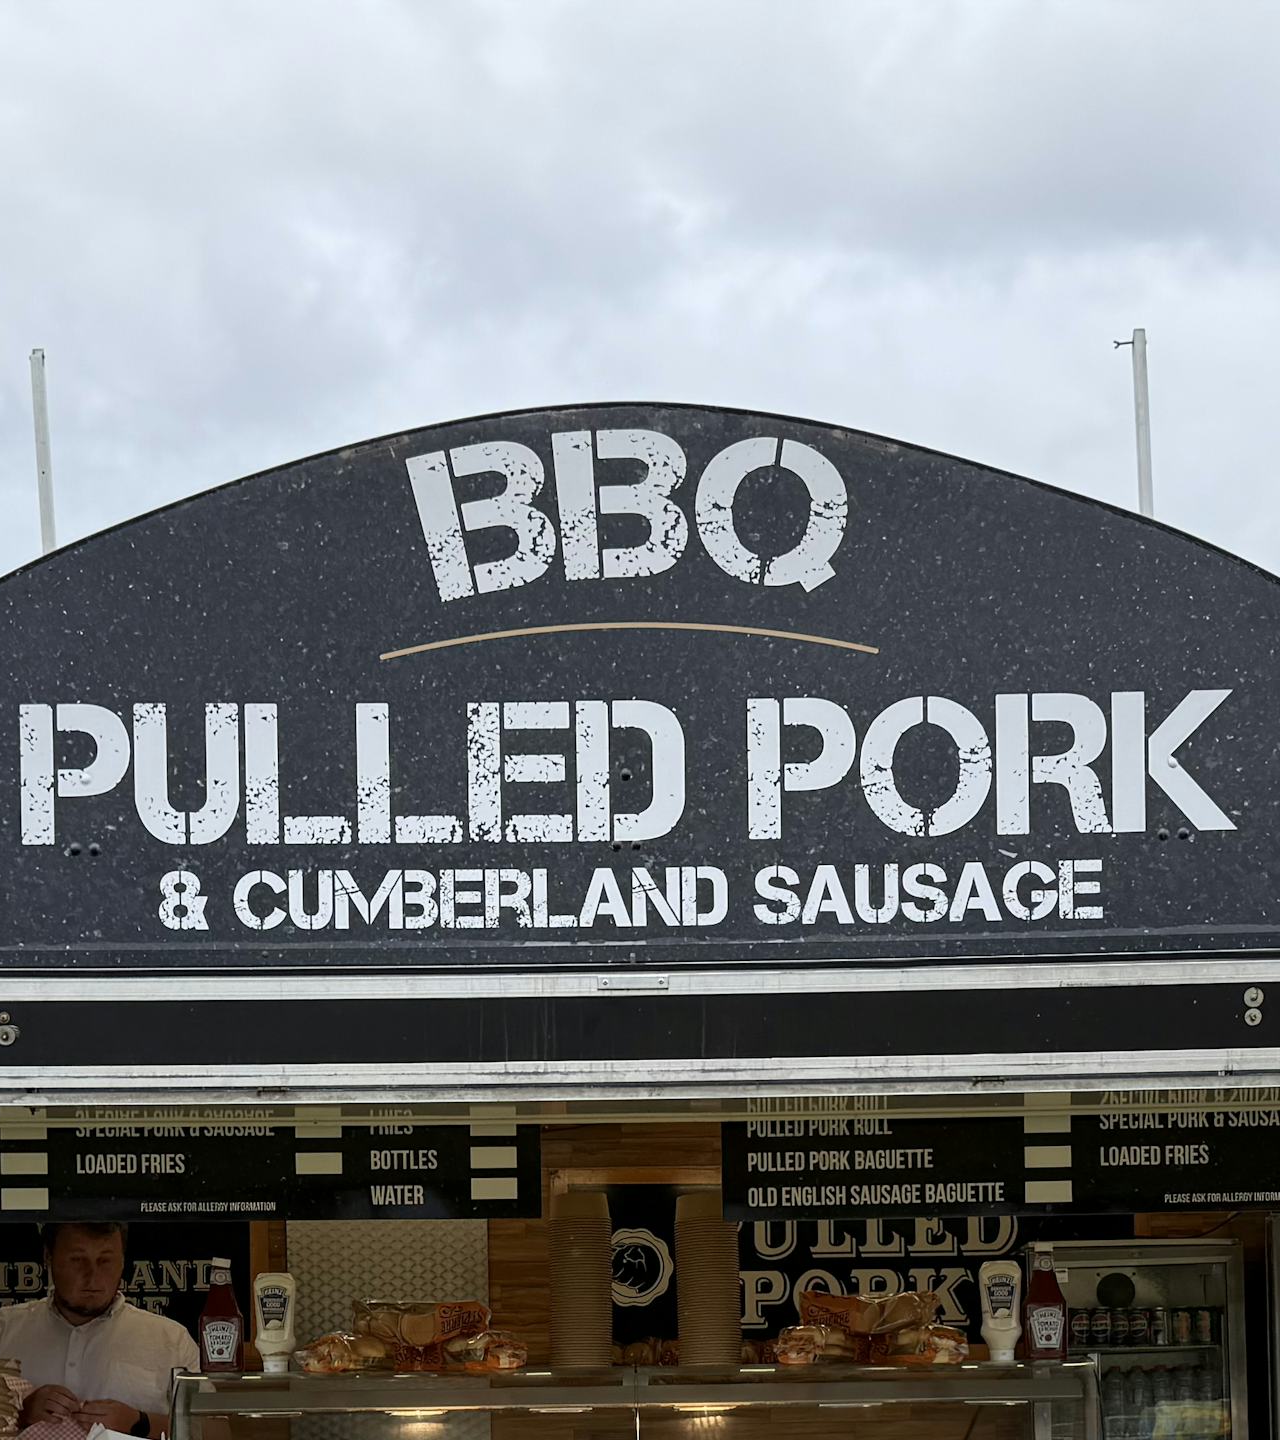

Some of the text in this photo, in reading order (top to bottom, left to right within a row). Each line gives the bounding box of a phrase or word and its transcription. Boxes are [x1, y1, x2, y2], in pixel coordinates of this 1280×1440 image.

[405, 427, 848, 601] BBQ
[19, 688, 1237, 845] PULLED PORK
[158, 857, 1103, 930] & CUMBERLAND SAUSAGE
[76, 1154, 185, 1174] LOADED FRIES
[370, 1150, 437, 1170] BOTTLES
[748, 1149, 933, 1172] PULLED PORK BAGUETTE
[1100, 1145, 1209, 1166] LOADED FRIES
[371, 1185, 424, 1205] WATER
[748, 1182, 1004, 1207] OLD ENGLISH SAUSAGE BAGUETTE
[1164, 1194, 1190, 1203] PLEASE
[1192, 1193, 1206, 1203] ASK
[1208, 1192, 1221, 1202] FOR
[1222, 1192, 1253, 1202] ALLERGY
[141, 1201, 276, 1212] PLEASE ASK FOR ALLERGY INFORMATION
[738, 1216, 1019, 1261] ULLED
